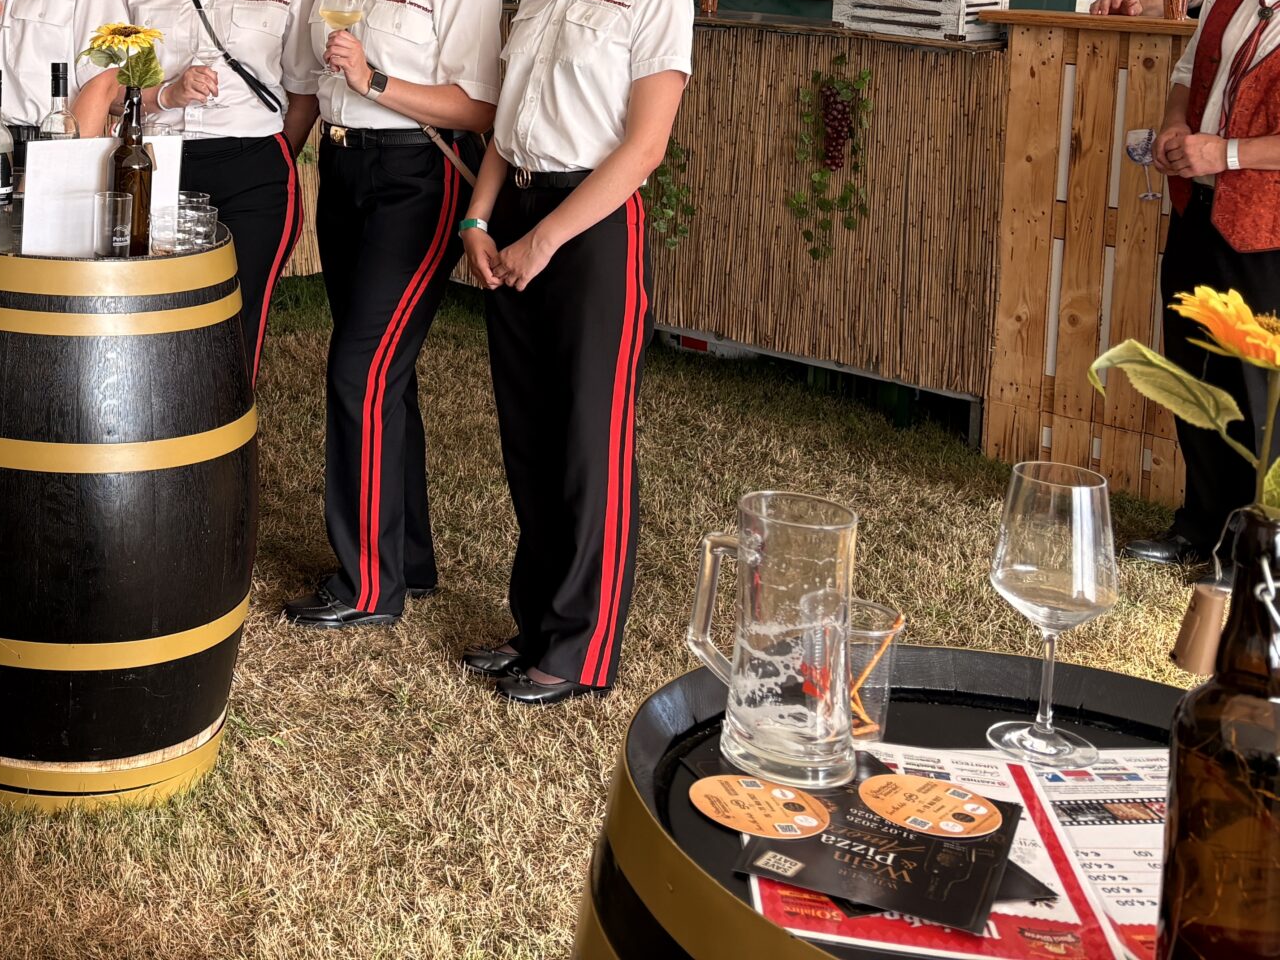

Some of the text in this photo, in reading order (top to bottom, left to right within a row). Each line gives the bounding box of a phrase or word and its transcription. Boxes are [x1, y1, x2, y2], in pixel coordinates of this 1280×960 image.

[846, 814, 917, 841] 31.07.2026
[820, 833, 897, 866] Pizza
[762, 860, 790, 874] SAVE
[770, 853, 798, 867] DATE
[833, 851, 912, 884] Wein
[816, 908, 843, 921] 50
